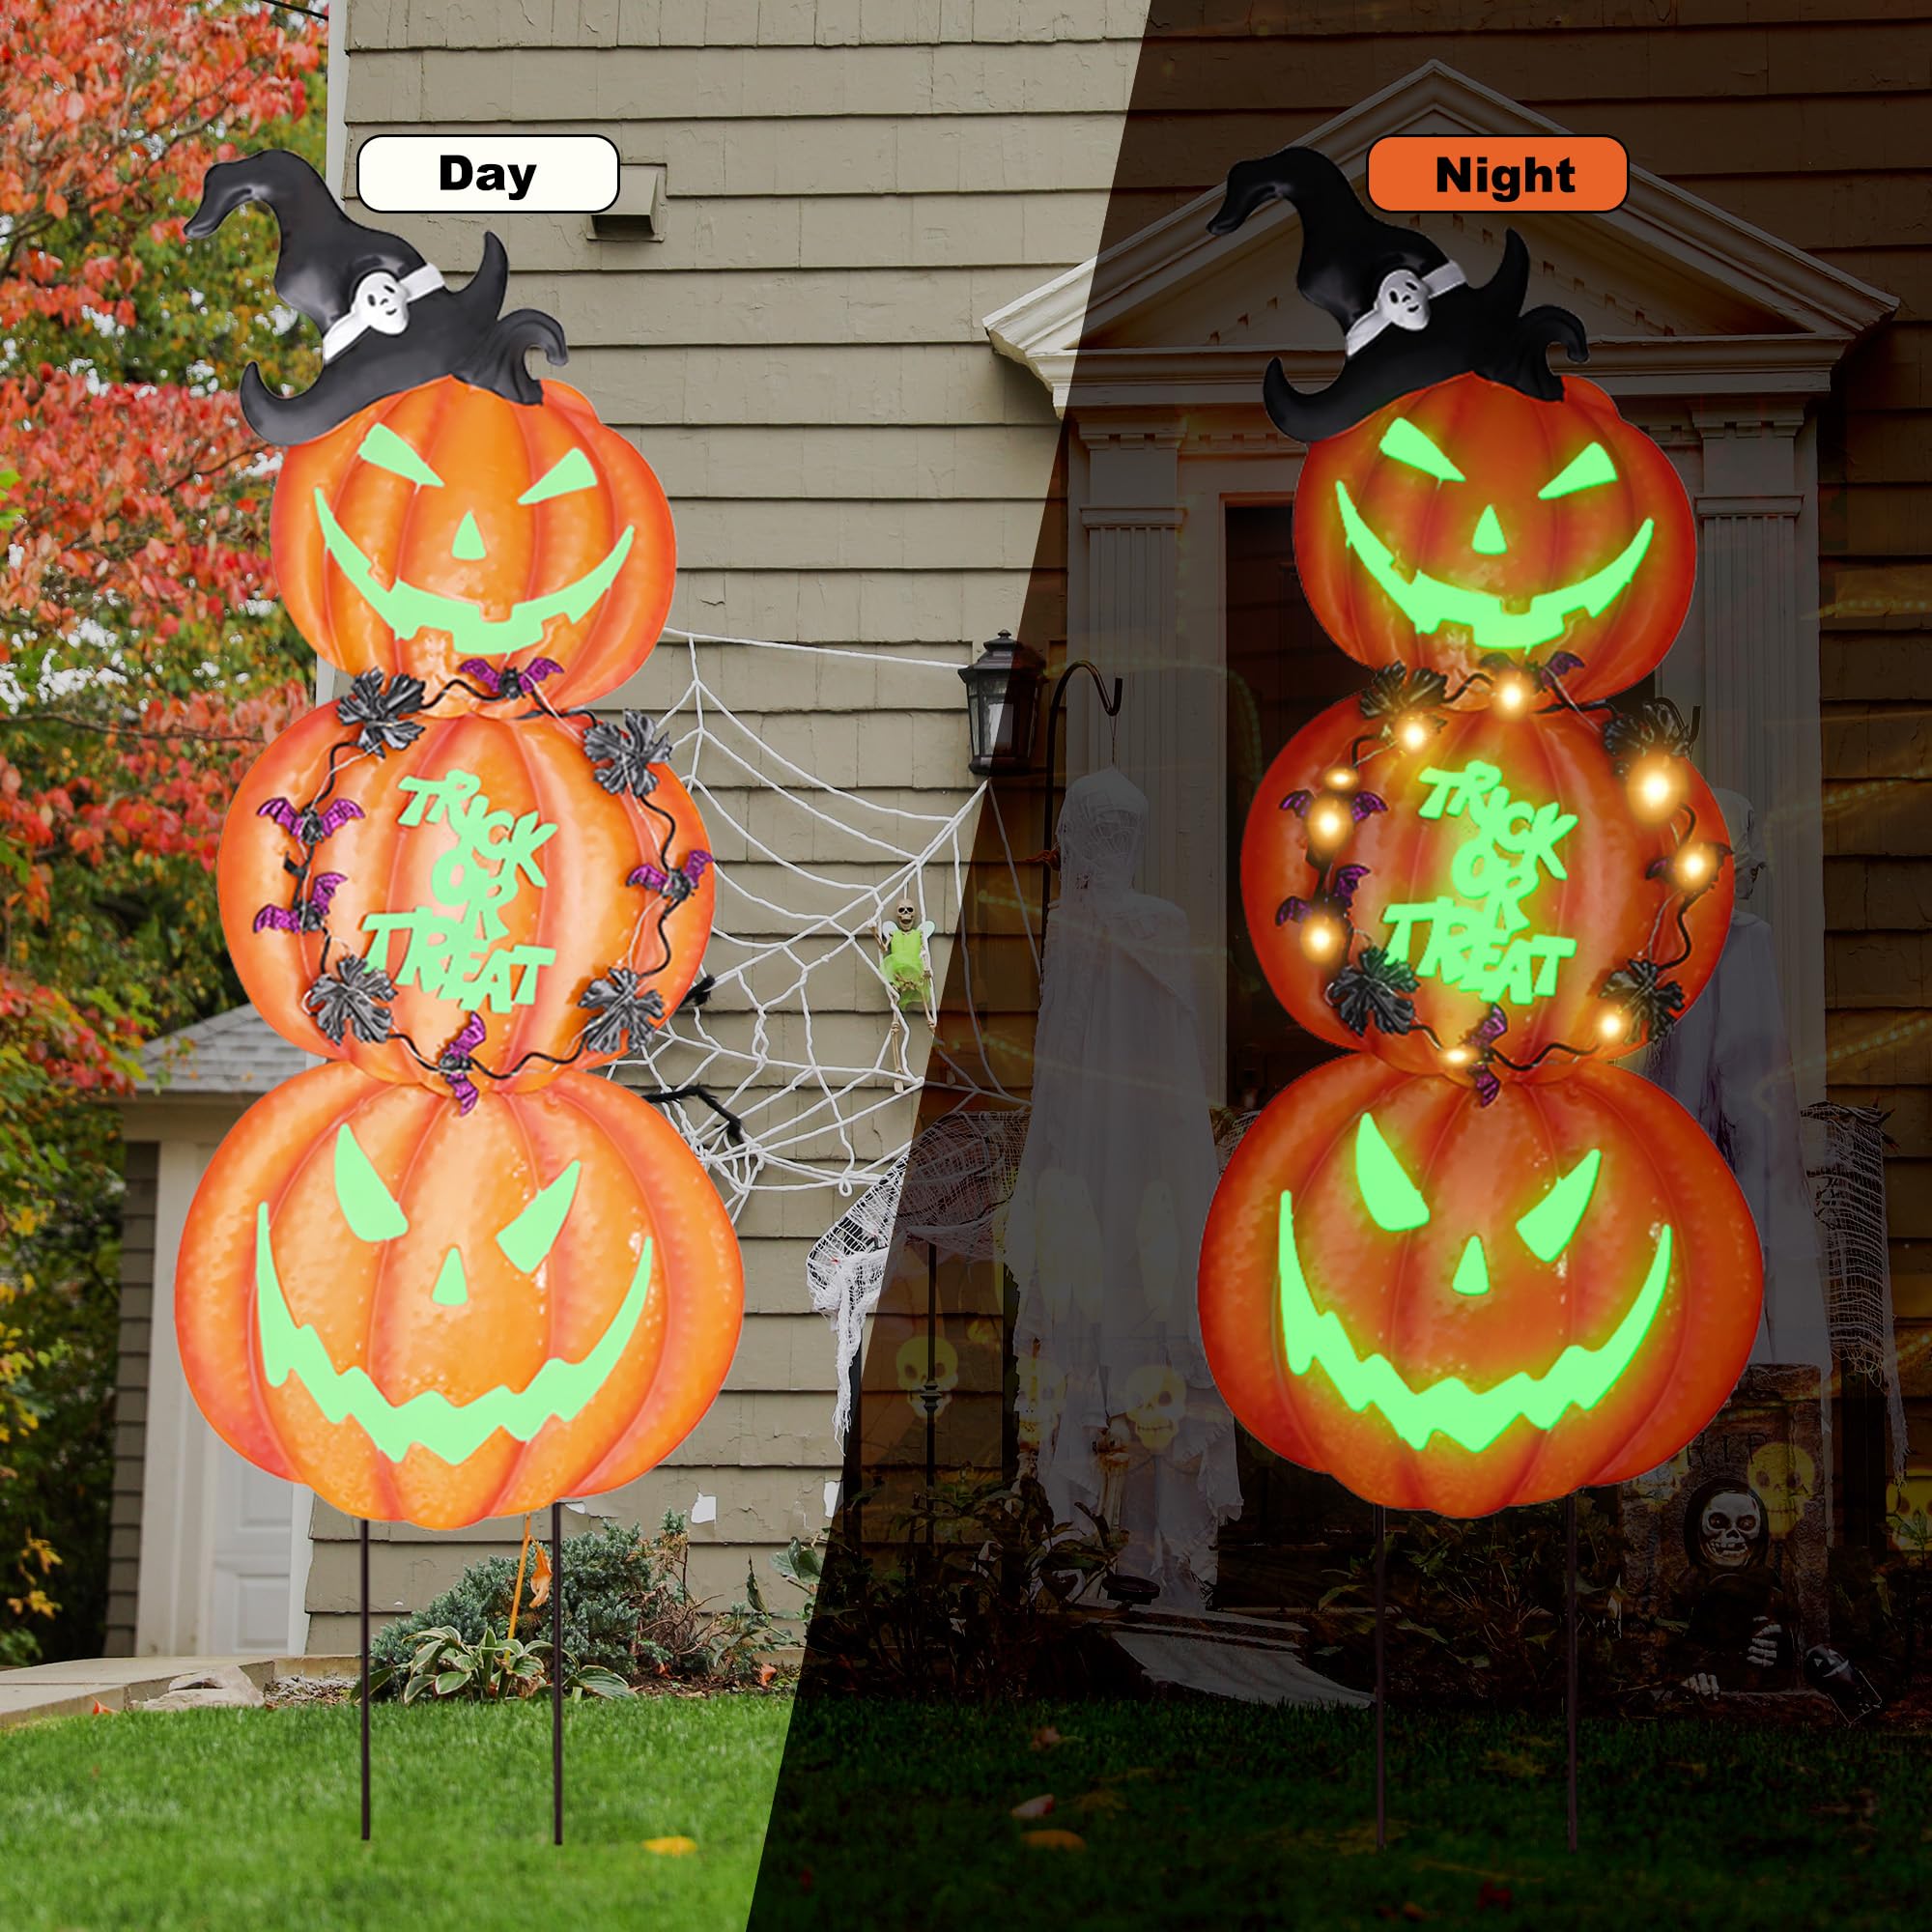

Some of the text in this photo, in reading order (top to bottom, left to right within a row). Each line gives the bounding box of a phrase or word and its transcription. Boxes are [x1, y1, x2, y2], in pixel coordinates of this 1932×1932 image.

[398, 770, 557, 888] TRICK
[1418, 759, 1578, 881] TRICK
[431, 847, 520, 941] OR
[1451, 838, 1540, 933] OR
[361, 906, 557, 1013] TREAT
[1382, 895, 1577, 1006] TREAT
